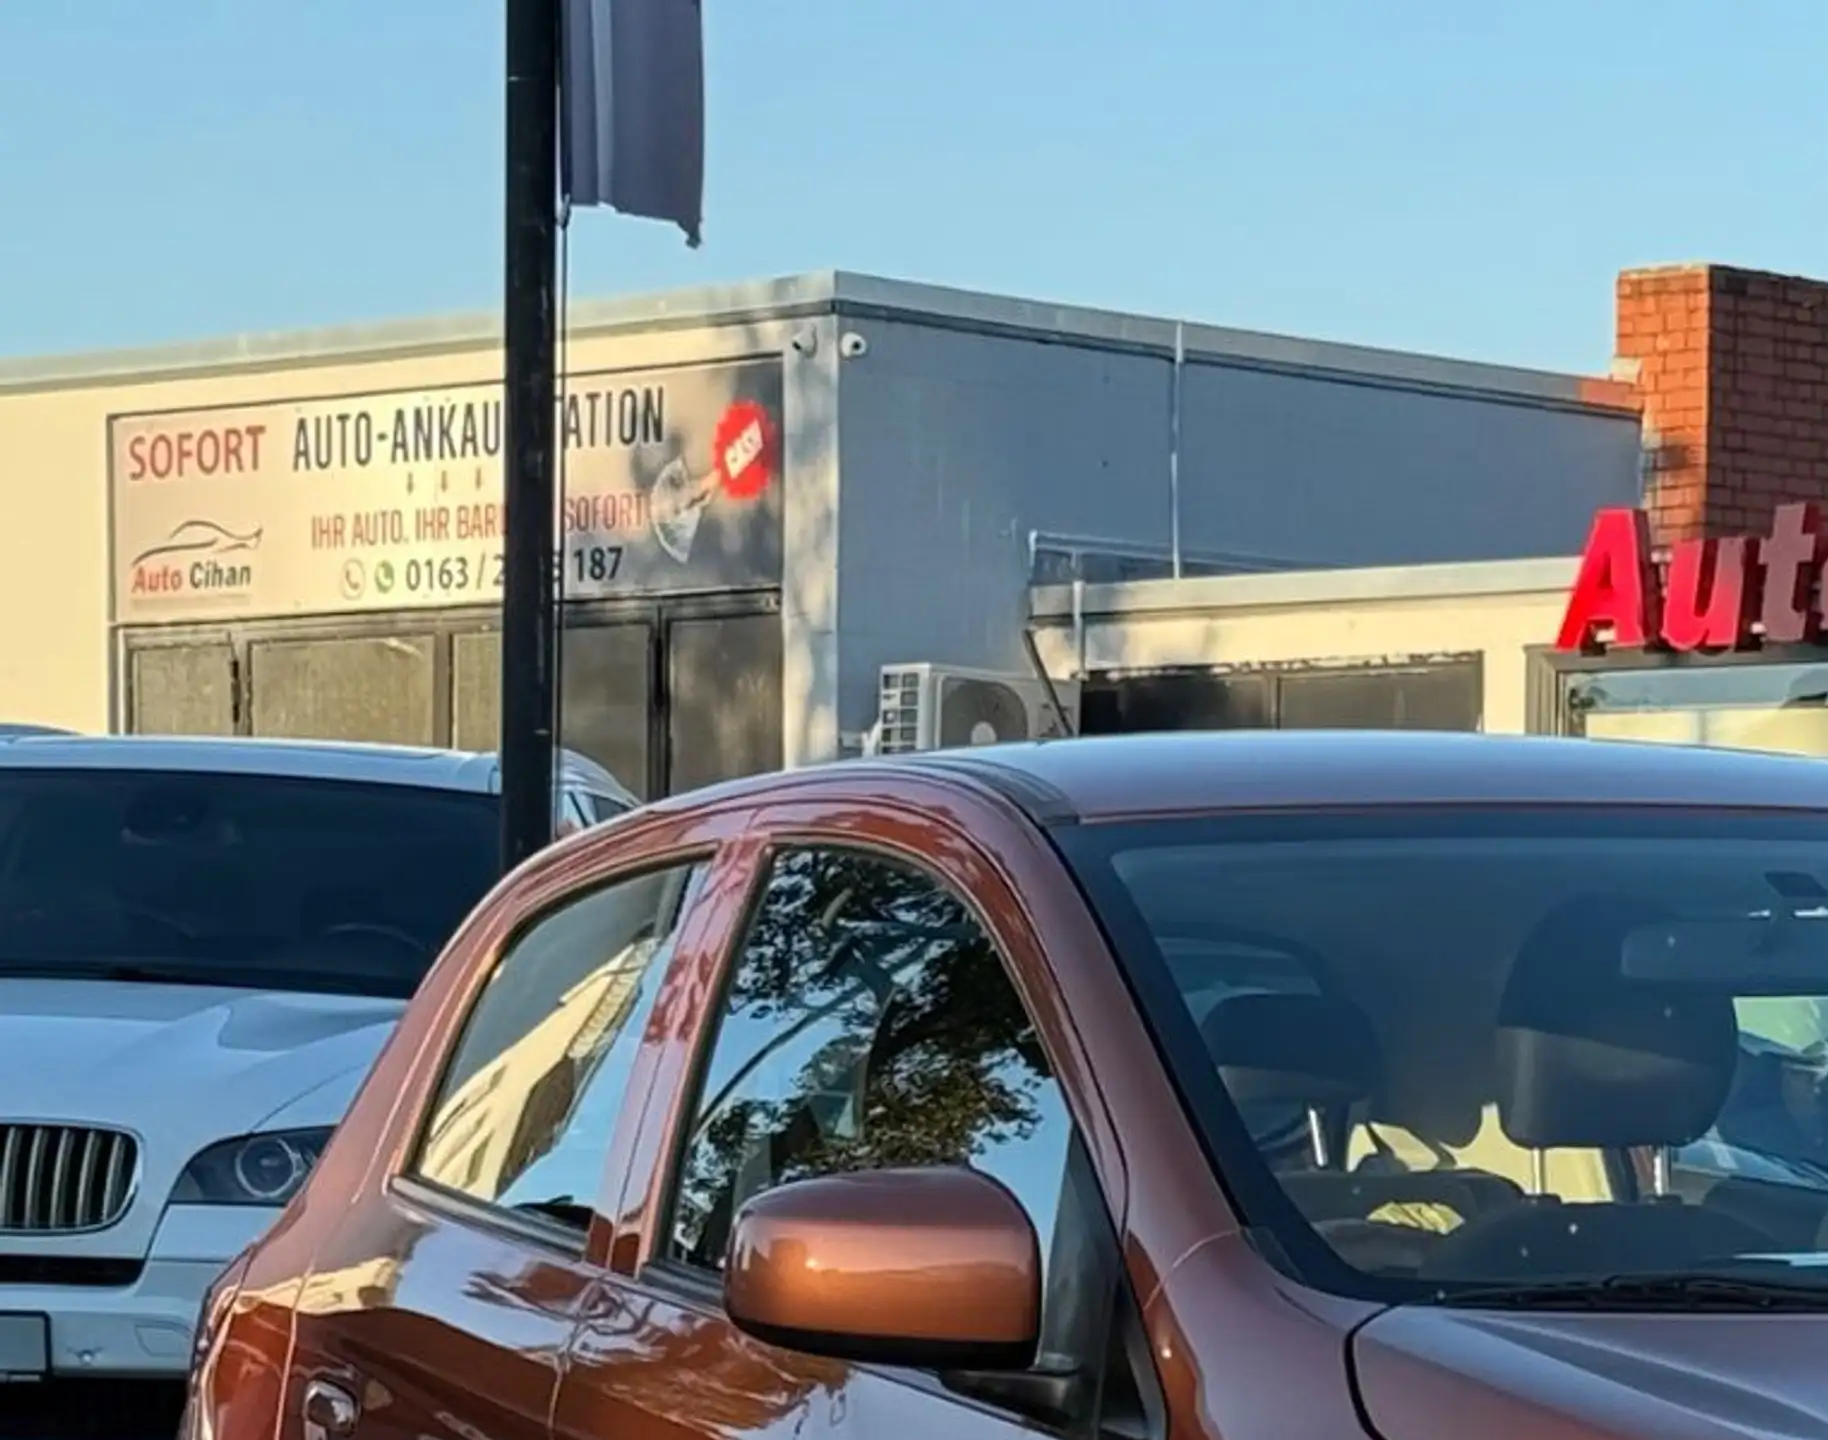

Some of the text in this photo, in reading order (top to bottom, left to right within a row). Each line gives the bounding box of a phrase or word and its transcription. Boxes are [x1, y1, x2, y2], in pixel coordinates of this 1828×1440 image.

[128, 425, 266, 481] SOFORT
[312, 514, 345, 551] IHR
[414, 506, 450, 542] IHR
[564, 493, 645, 533] SOFORT
[131, 559, 252, 594] Auto Cihan
[405, 556, 469, 591] 0163
[573, 547, 623, 582] 187
